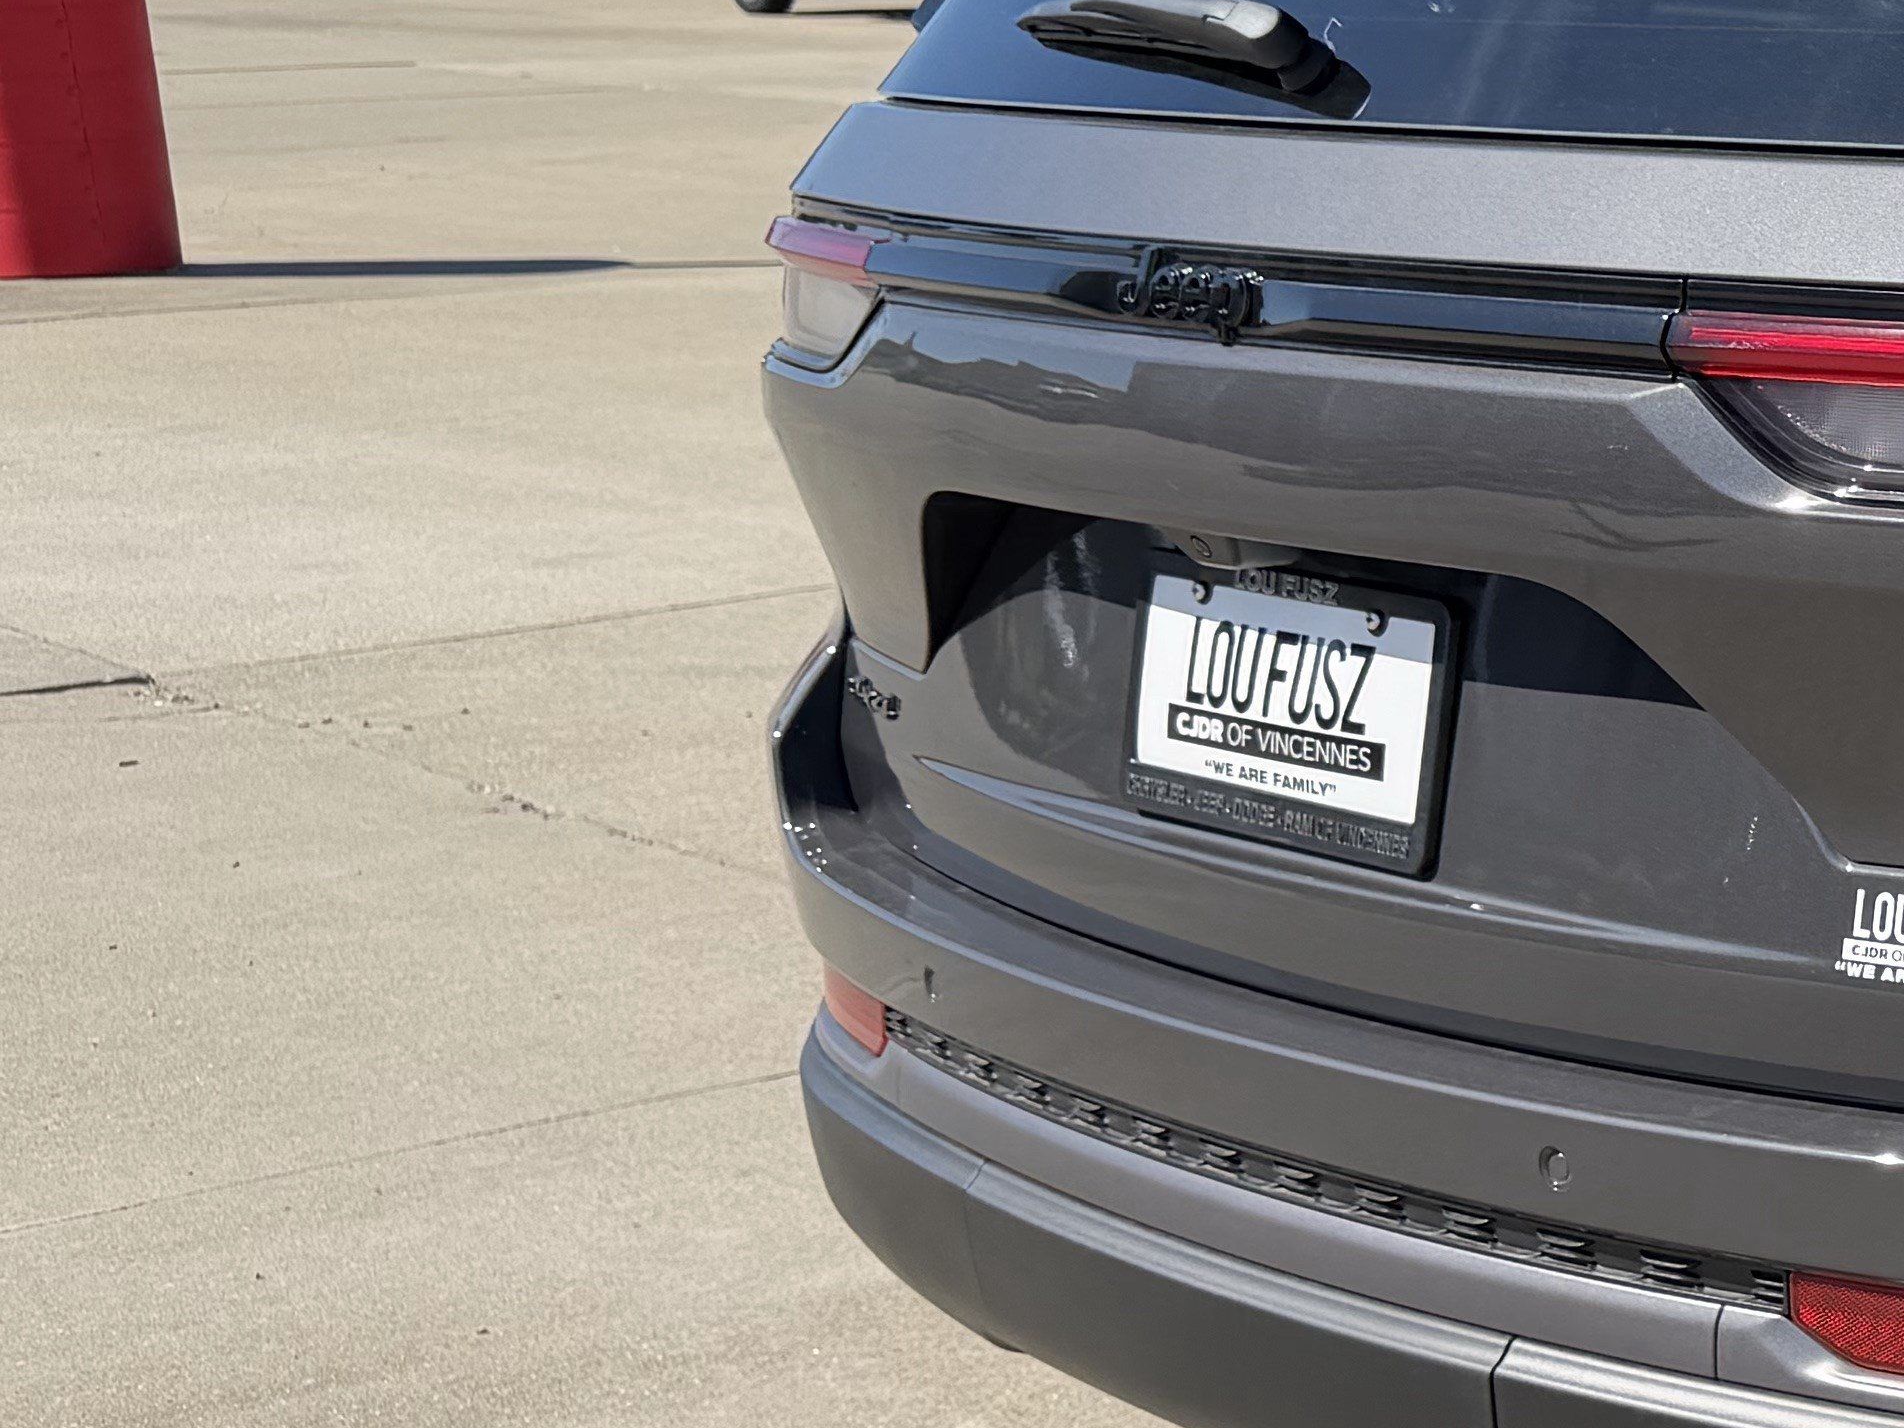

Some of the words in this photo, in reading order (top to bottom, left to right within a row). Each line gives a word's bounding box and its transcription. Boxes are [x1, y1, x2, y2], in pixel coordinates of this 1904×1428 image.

[1117, 245, 1262, 345] Jeep
[1234, 568, 1277, 596] LOU
[1175, 711, 1225, 743] CJDR
[1226, 721, 1254, 748] OF
[1256, 727, 1372, 773] VINCENNES
[1238, 766, 1268, 785] ARE
[1851, 944, 1888, 960] CJDR
